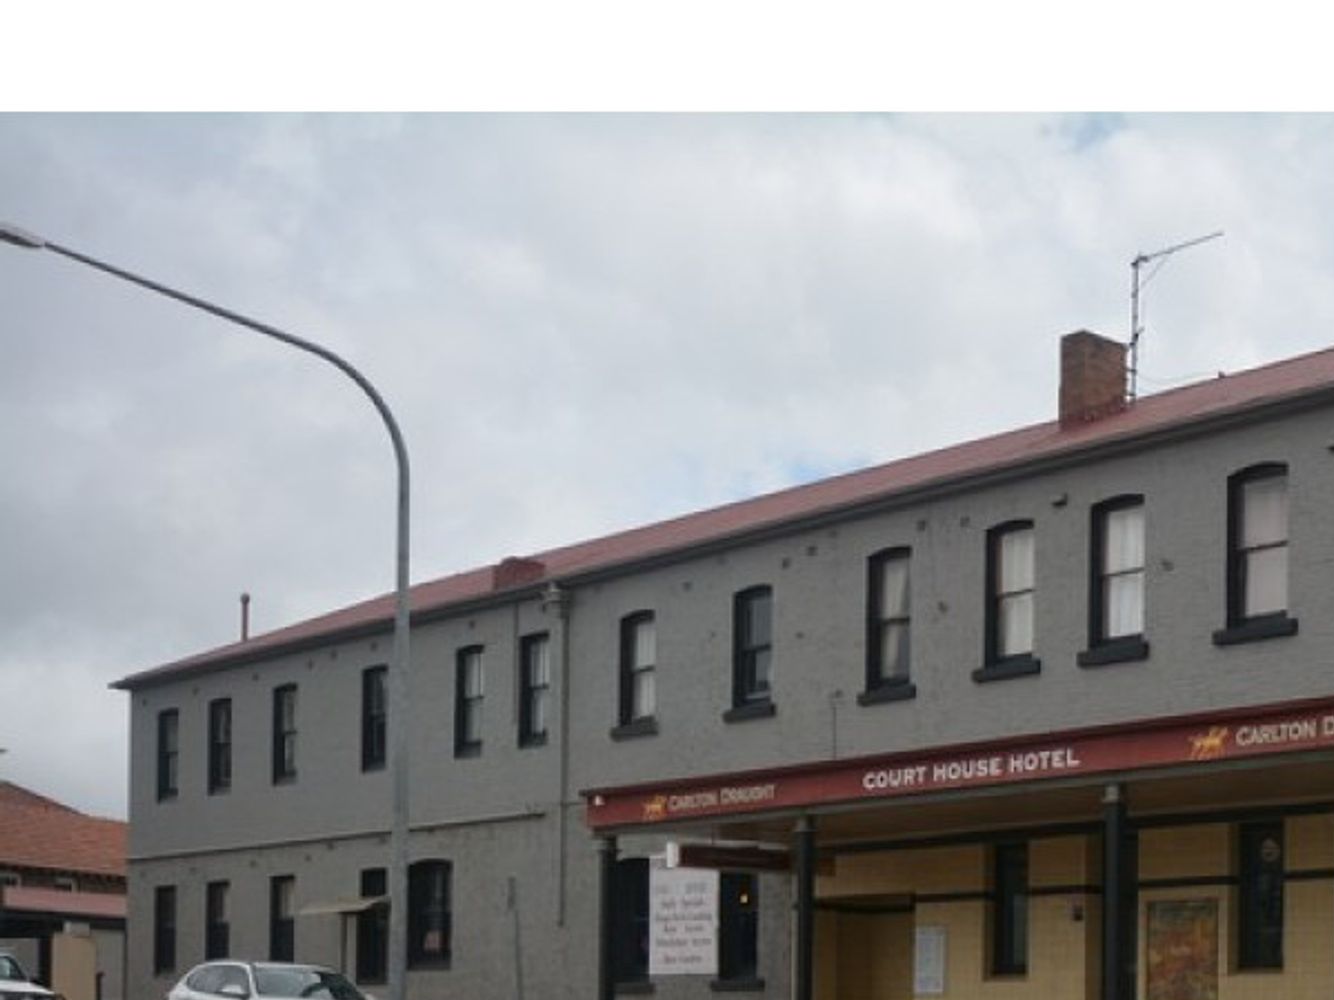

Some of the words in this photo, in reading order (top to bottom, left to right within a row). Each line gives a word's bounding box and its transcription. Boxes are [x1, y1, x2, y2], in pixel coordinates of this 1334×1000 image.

[1235, 720, 1317, 746] CARLTON
[862, 765, 927, 790] COURT
[932, 757, 1001, 782] HOUSE
[1009, 748, 1081, 774] HOTEL
[667, 791, 718, 811] CARLTON
[719, 784, 775, 804] DRAUGHT
